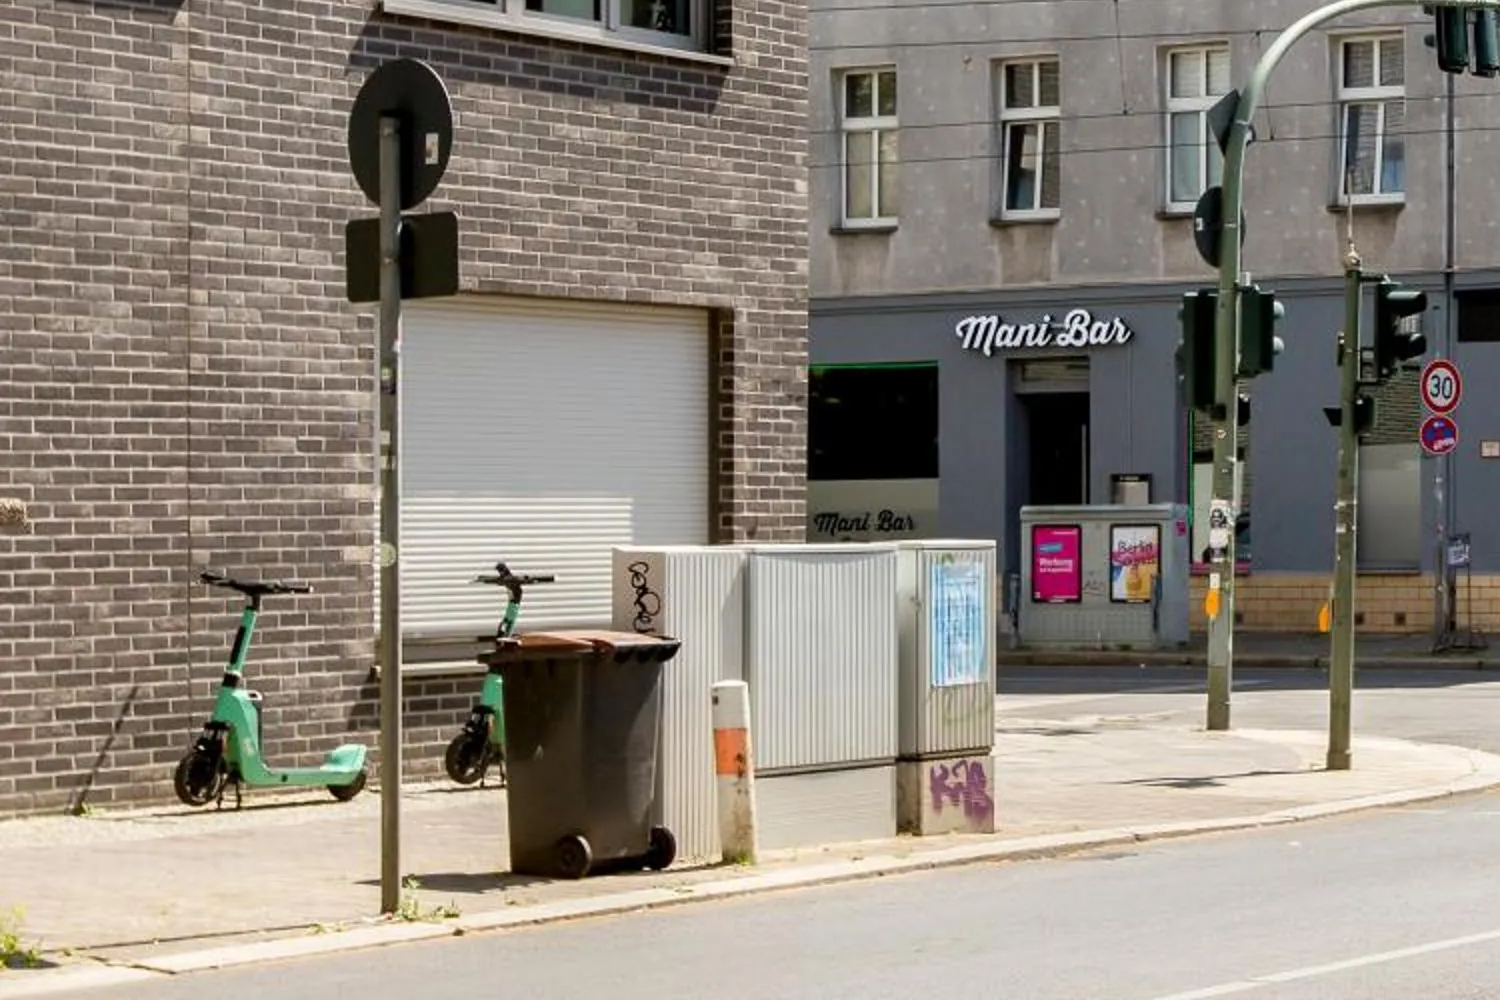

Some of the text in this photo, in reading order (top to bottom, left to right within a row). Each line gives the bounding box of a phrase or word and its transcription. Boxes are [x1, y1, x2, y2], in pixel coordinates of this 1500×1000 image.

[955, 308, 1132, 357] Mani Bar
[1430, 374, 1453, 399] 30
[813, 509, 914, 535] Mani Bar
